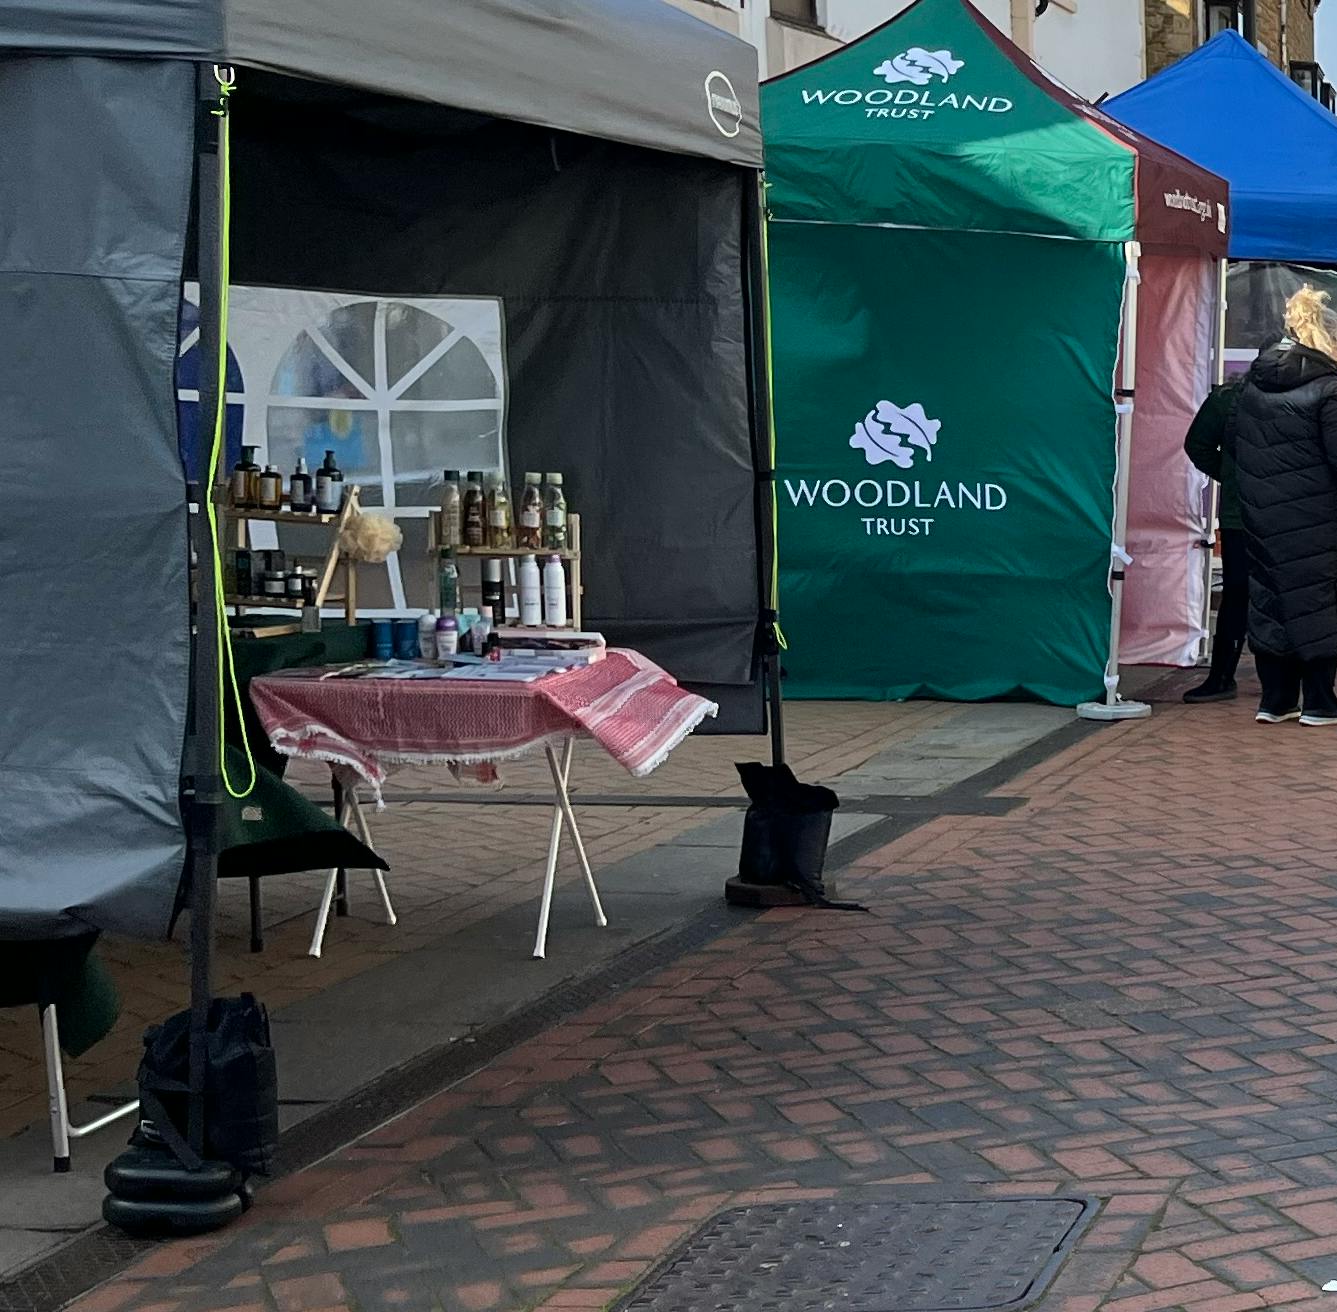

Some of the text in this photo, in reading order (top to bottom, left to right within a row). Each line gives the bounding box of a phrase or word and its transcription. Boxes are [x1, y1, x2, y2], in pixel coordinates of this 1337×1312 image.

[801, 89, 1013, 113] WOODLAND
[865, 108, 935, 120] TRUST
[784, 479, 1008, 510] WOODLAND
[860, 517, 934, 536] TRUST
